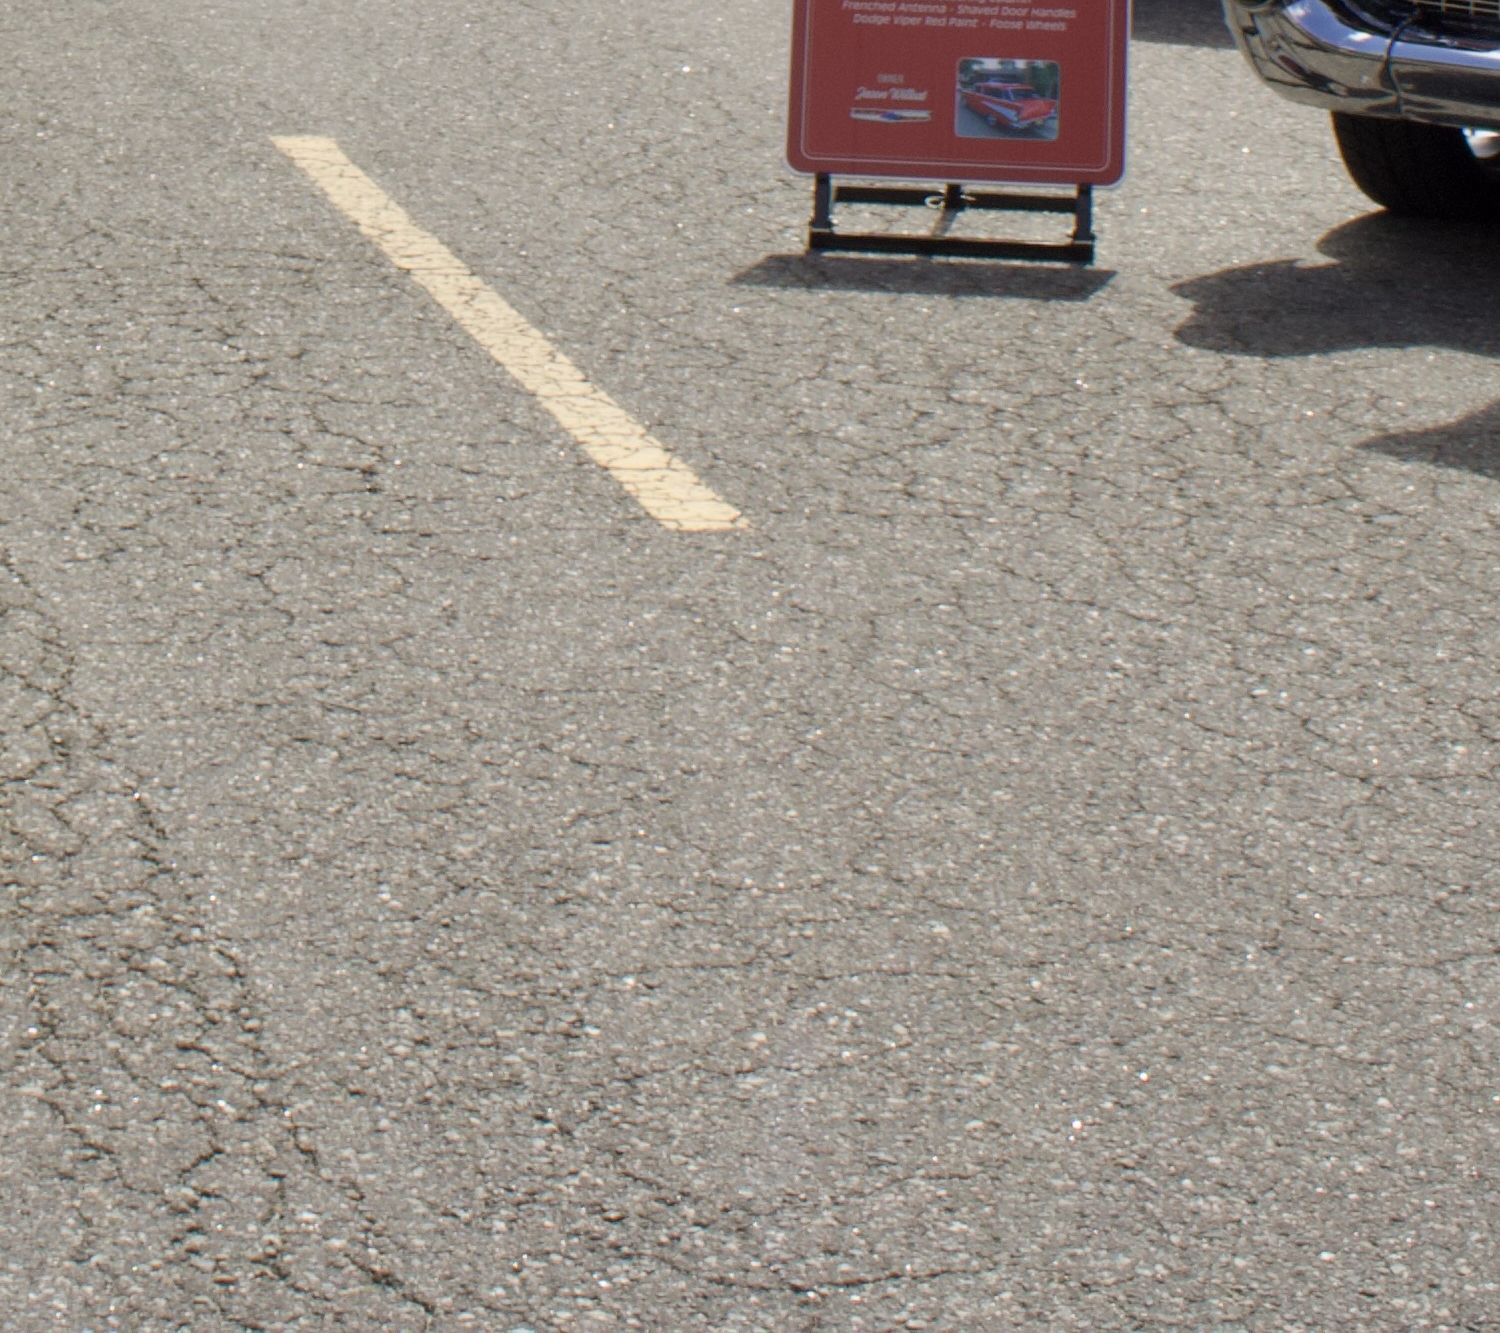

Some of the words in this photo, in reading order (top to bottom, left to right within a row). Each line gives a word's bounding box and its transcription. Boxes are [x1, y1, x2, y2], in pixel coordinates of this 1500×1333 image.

[1000, 7, 1029, 16] Door
[1030, 9, 1077, 19] Handles
[852, 13, 891, 25] Dodge
[893, 15, 922, 26] Viper
[924, 17, 947, 27] Red
[948, 17, 978, 28] Paint
[1026, 20, 1067, 31] Wheels
